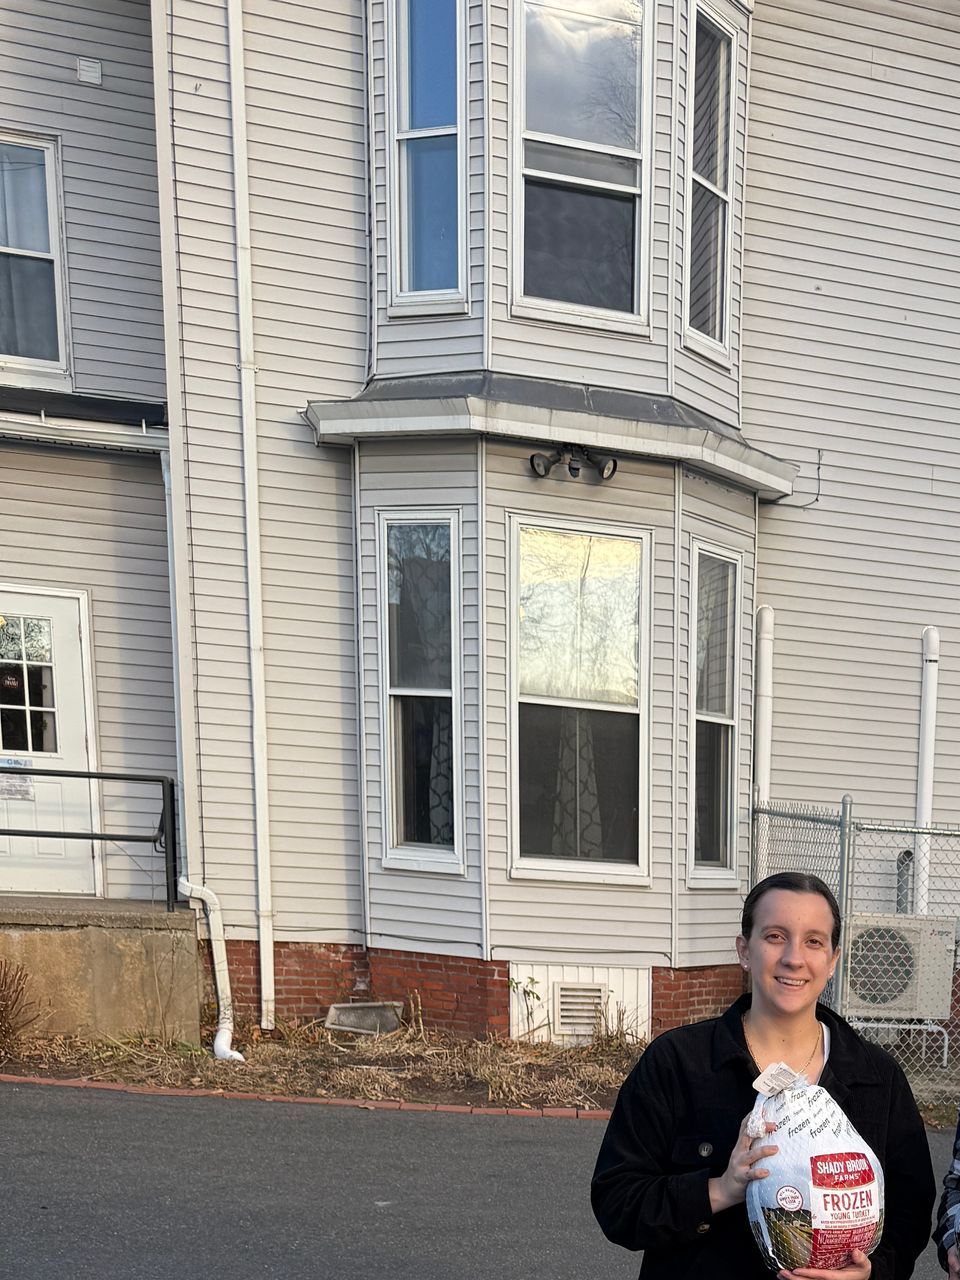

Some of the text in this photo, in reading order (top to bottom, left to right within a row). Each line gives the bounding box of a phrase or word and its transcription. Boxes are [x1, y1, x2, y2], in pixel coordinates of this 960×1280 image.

[774, 1114, 791, 1132] ozen
[788, 1118, 811, 1139] frozen
[809, 1117, 831, 1139] frozen
[817, 1158, 869, 1175] SHADY BROOK
[823, 1189, 873, 1212] FROZEN
[830, 1209, 870, 1220] YOUNG TURKEY
